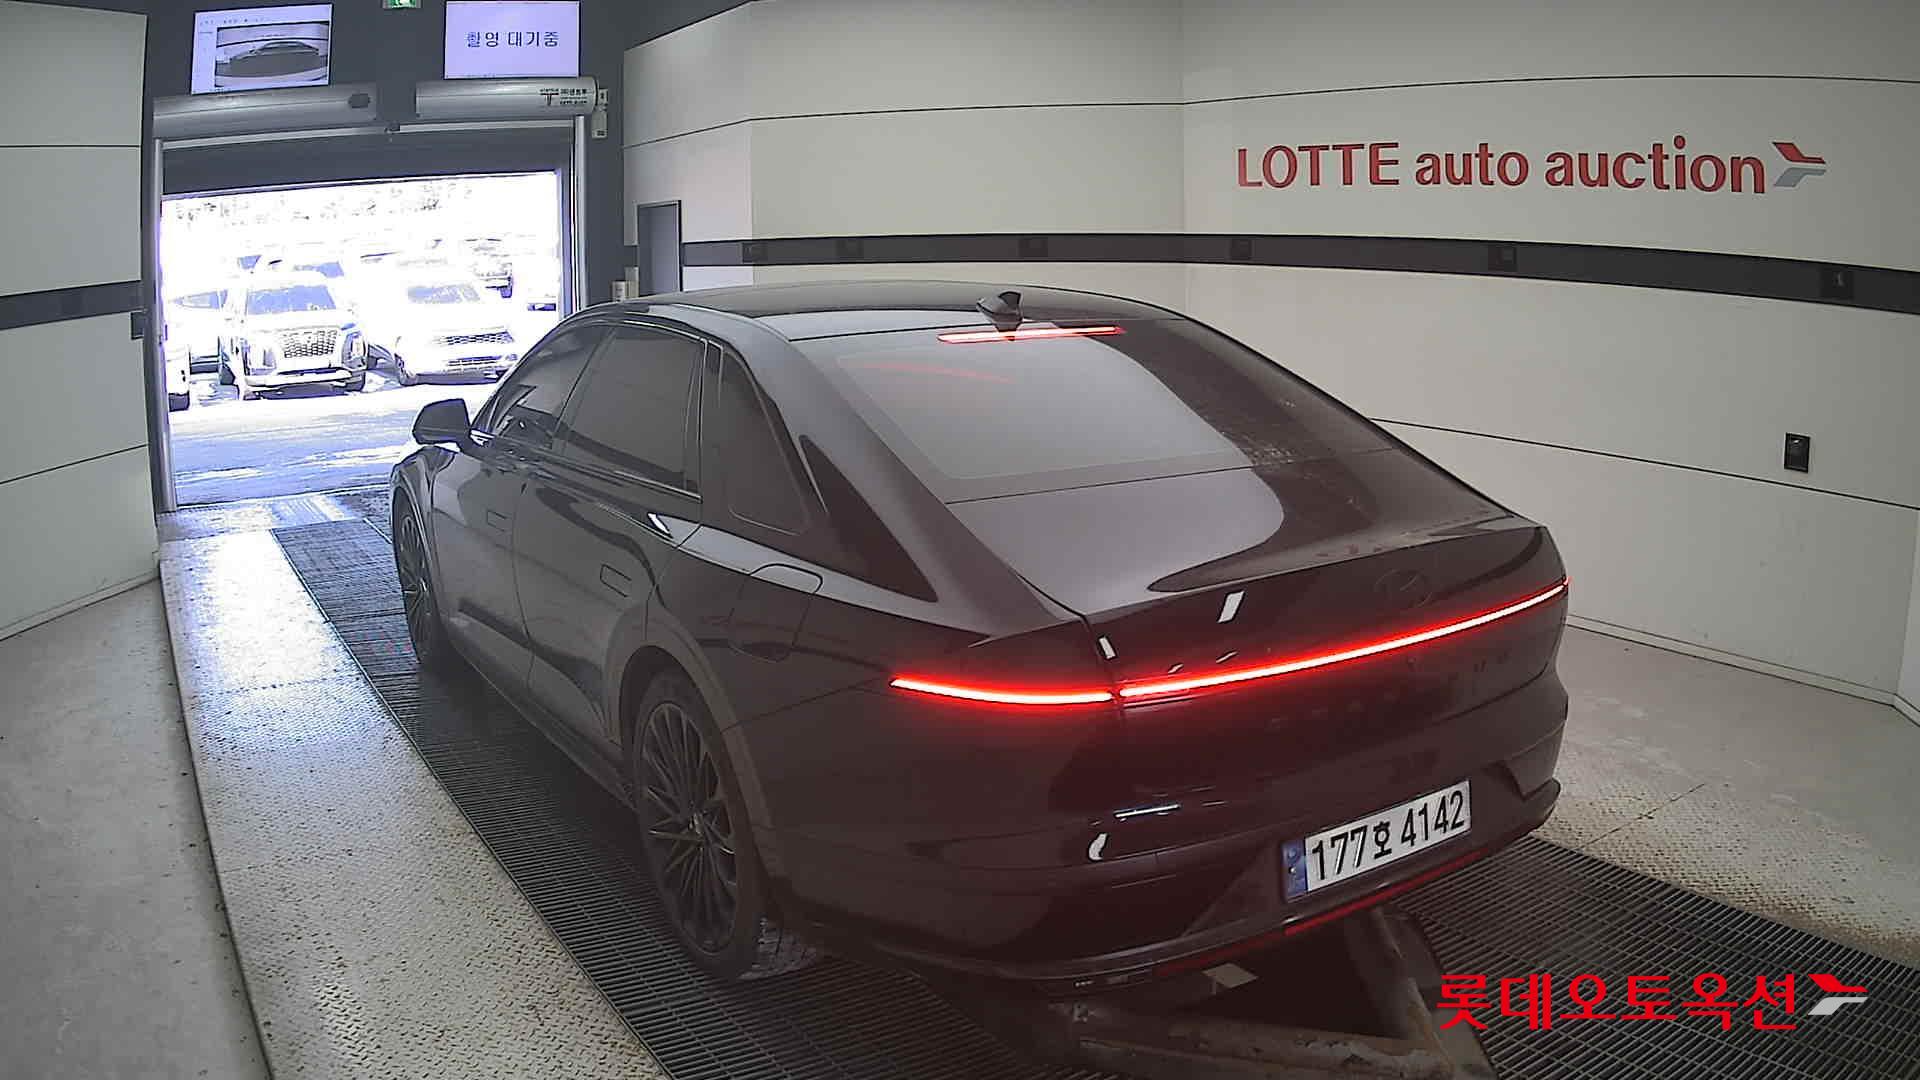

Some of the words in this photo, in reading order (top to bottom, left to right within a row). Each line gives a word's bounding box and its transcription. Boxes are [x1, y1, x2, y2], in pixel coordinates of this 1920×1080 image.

[508, 31, 560, 47] 대기중
[1237, 142, 1400, 189] LOTTE
[1415, 142, 1529, 187] auto
[1545, 135, 1766, 194] auction
[1312, 821, 1392, 880] 177호
[1401, 790, 1465, 847] 4142
